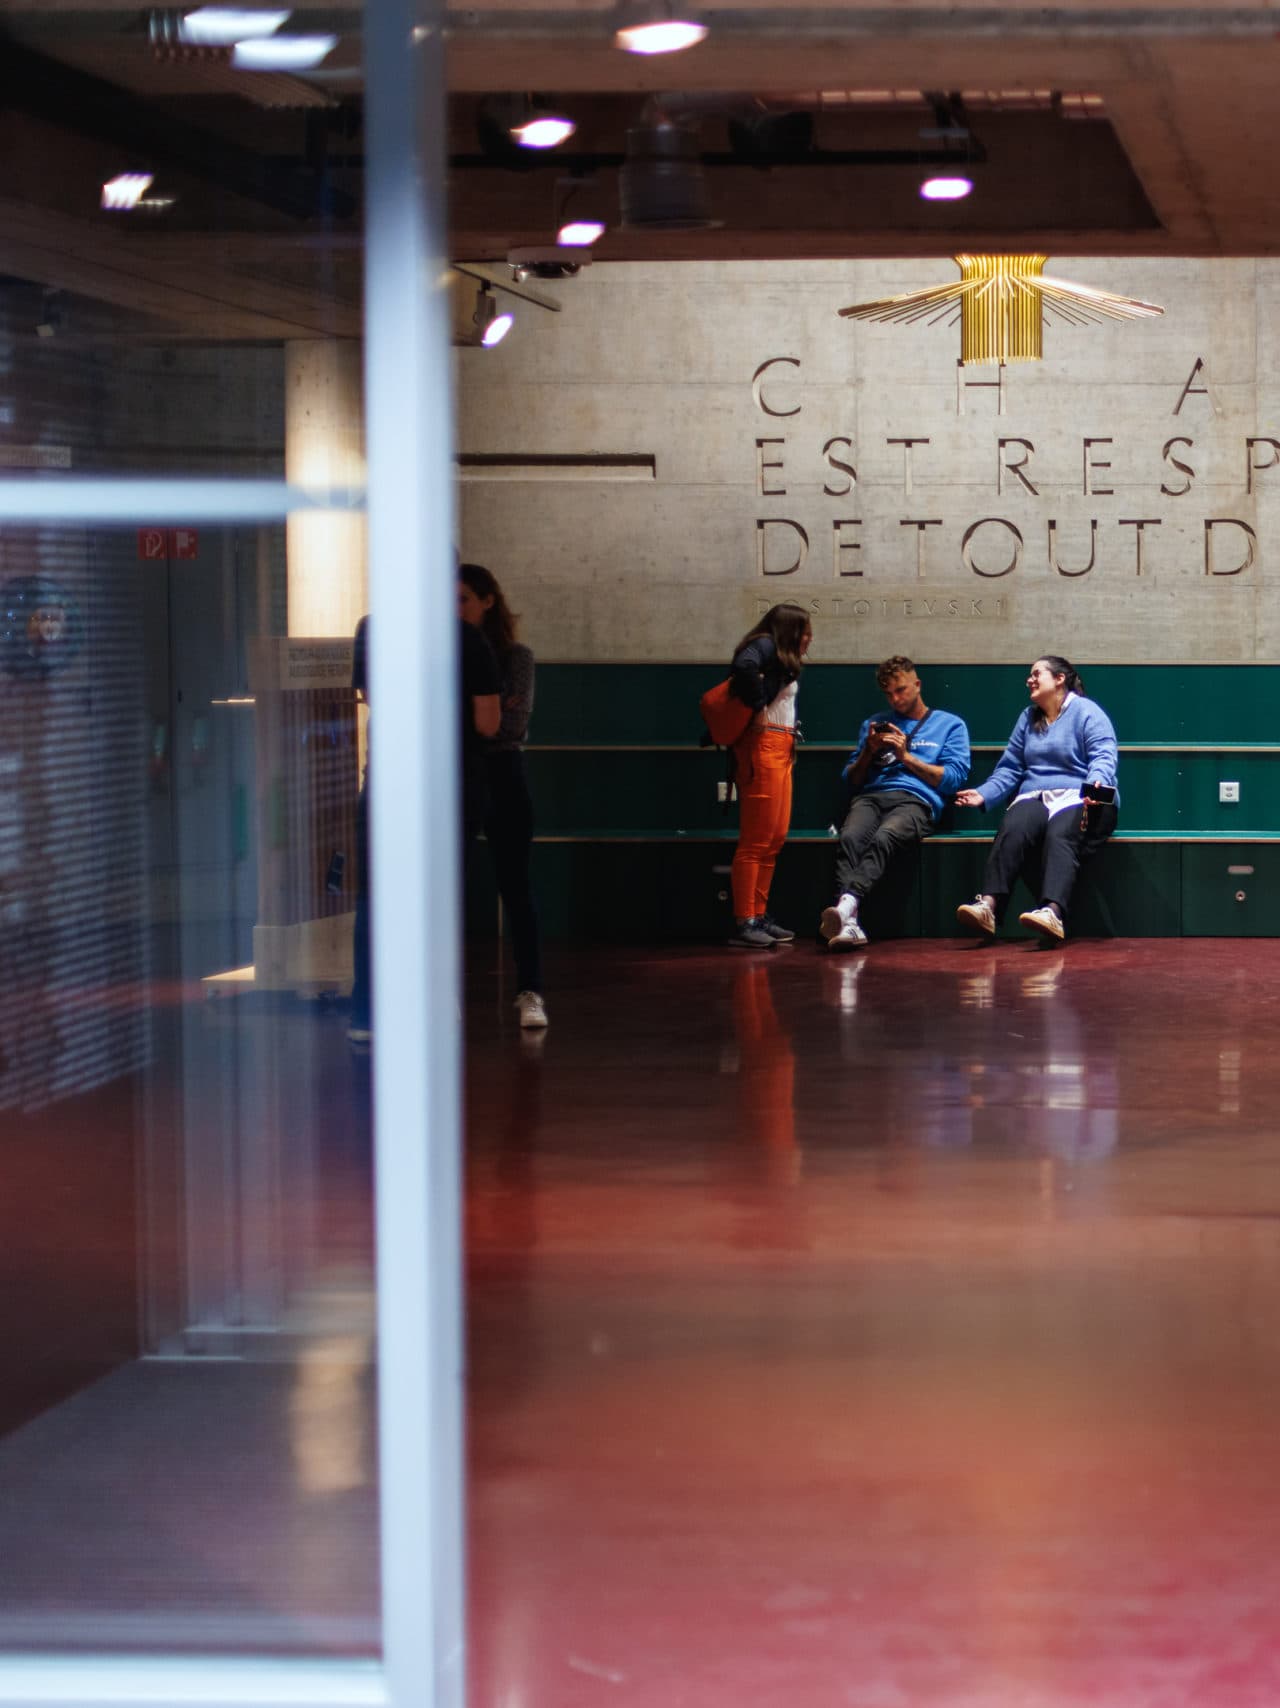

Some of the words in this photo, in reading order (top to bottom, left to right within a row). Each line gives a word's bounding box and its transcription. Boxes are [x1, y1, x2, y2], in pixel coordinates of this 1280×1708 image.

[755, 436, 930, 497] EST
[756, 517, 864, 577] DE
[900, 517, 1163, 577] TOUT
